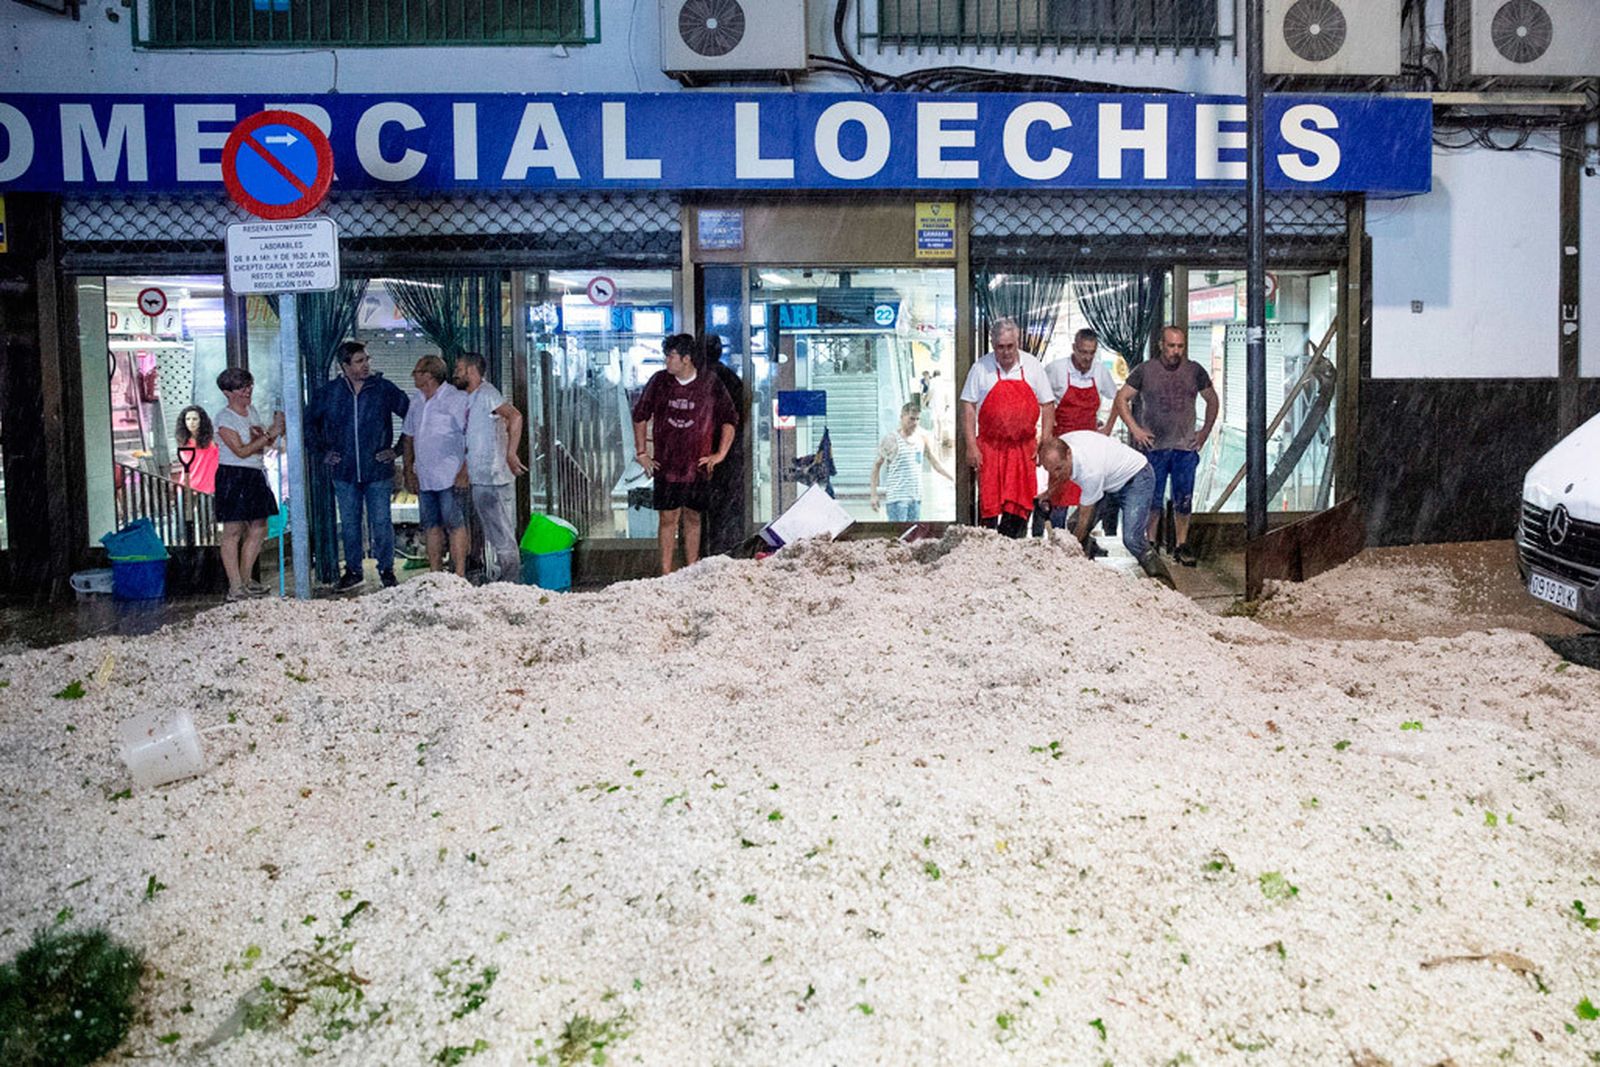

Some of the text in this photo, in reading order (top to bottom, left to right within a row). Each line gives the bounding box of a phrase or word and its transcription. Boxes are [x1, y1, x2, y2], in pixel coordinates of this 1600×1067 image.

[0, 101, 1341, 182] MECIAL LOECHES
[242, 224, 273, 233] RESERVA
[260, 242, 304, 250] LABORABLES
[234, 255, 243, 263] DE
[233, 263, 263, 272] EXCEPTO
[265, 262, 287, 270] CARGA
[296, 260, 331, 269] DESCARGA
[251, 270, 315, 280] RESTO DE HORARIO
[876, 309, 892, 320] 22
